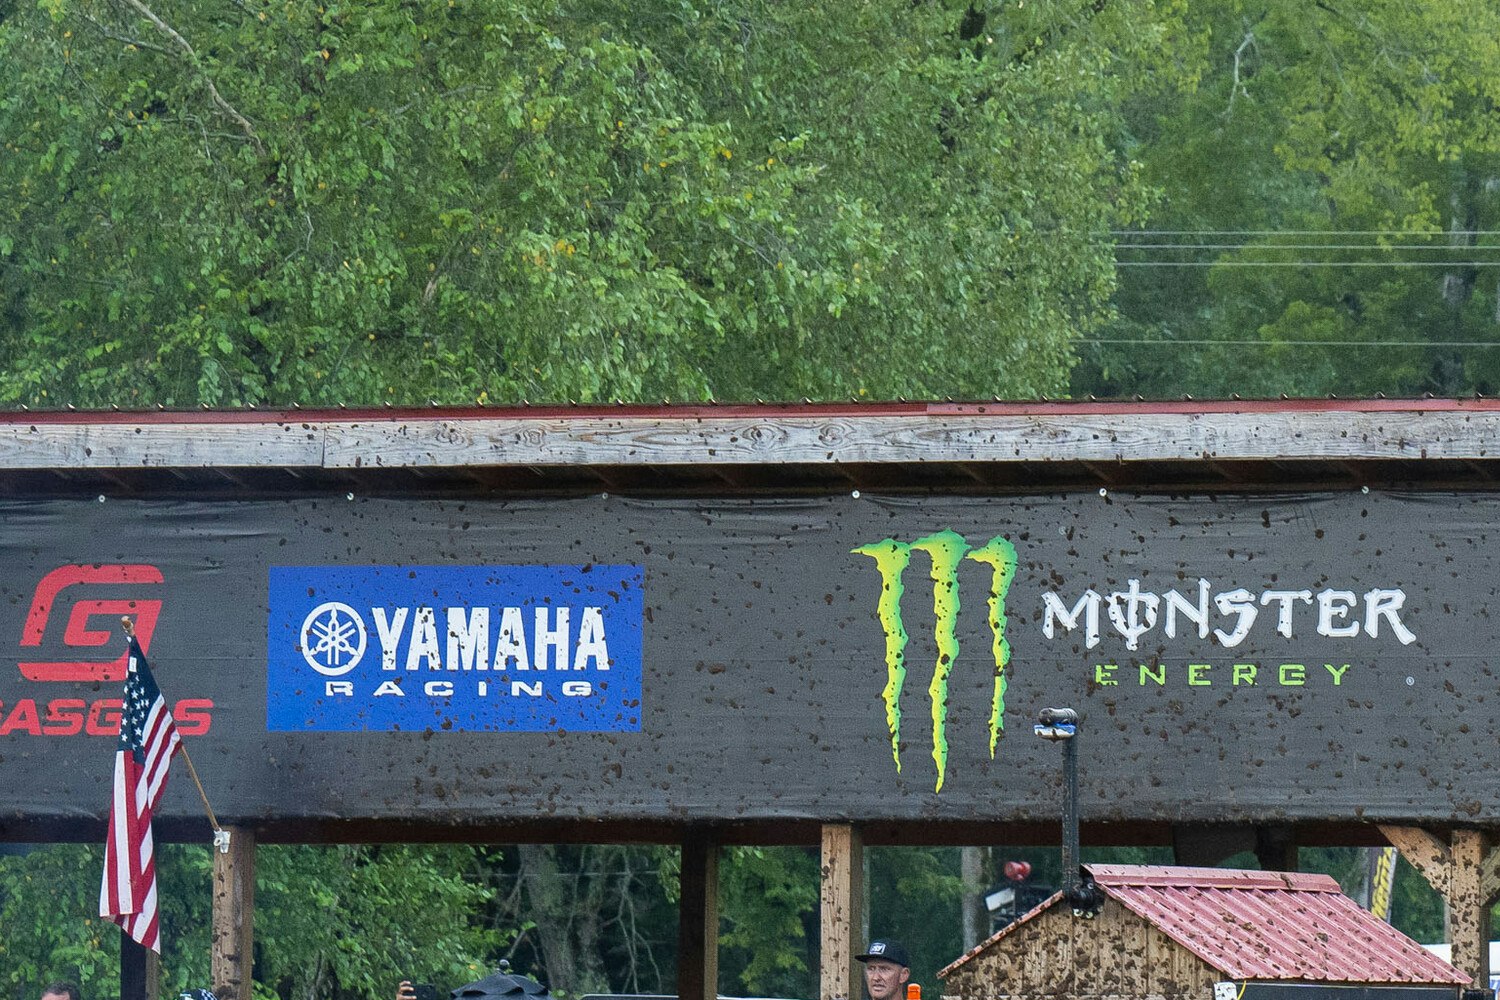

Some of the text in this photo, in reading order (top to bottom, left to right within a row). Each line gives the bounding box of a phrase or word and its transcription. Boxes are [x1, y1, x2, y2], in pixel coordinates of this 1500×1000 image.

[1041, 578, 1417, 651] MONSTER
[372, 606, 610, 671] YAMAHA
[325, 680, 594, 698] RACING
[1095, 664, 1351, 687] ENERGY
